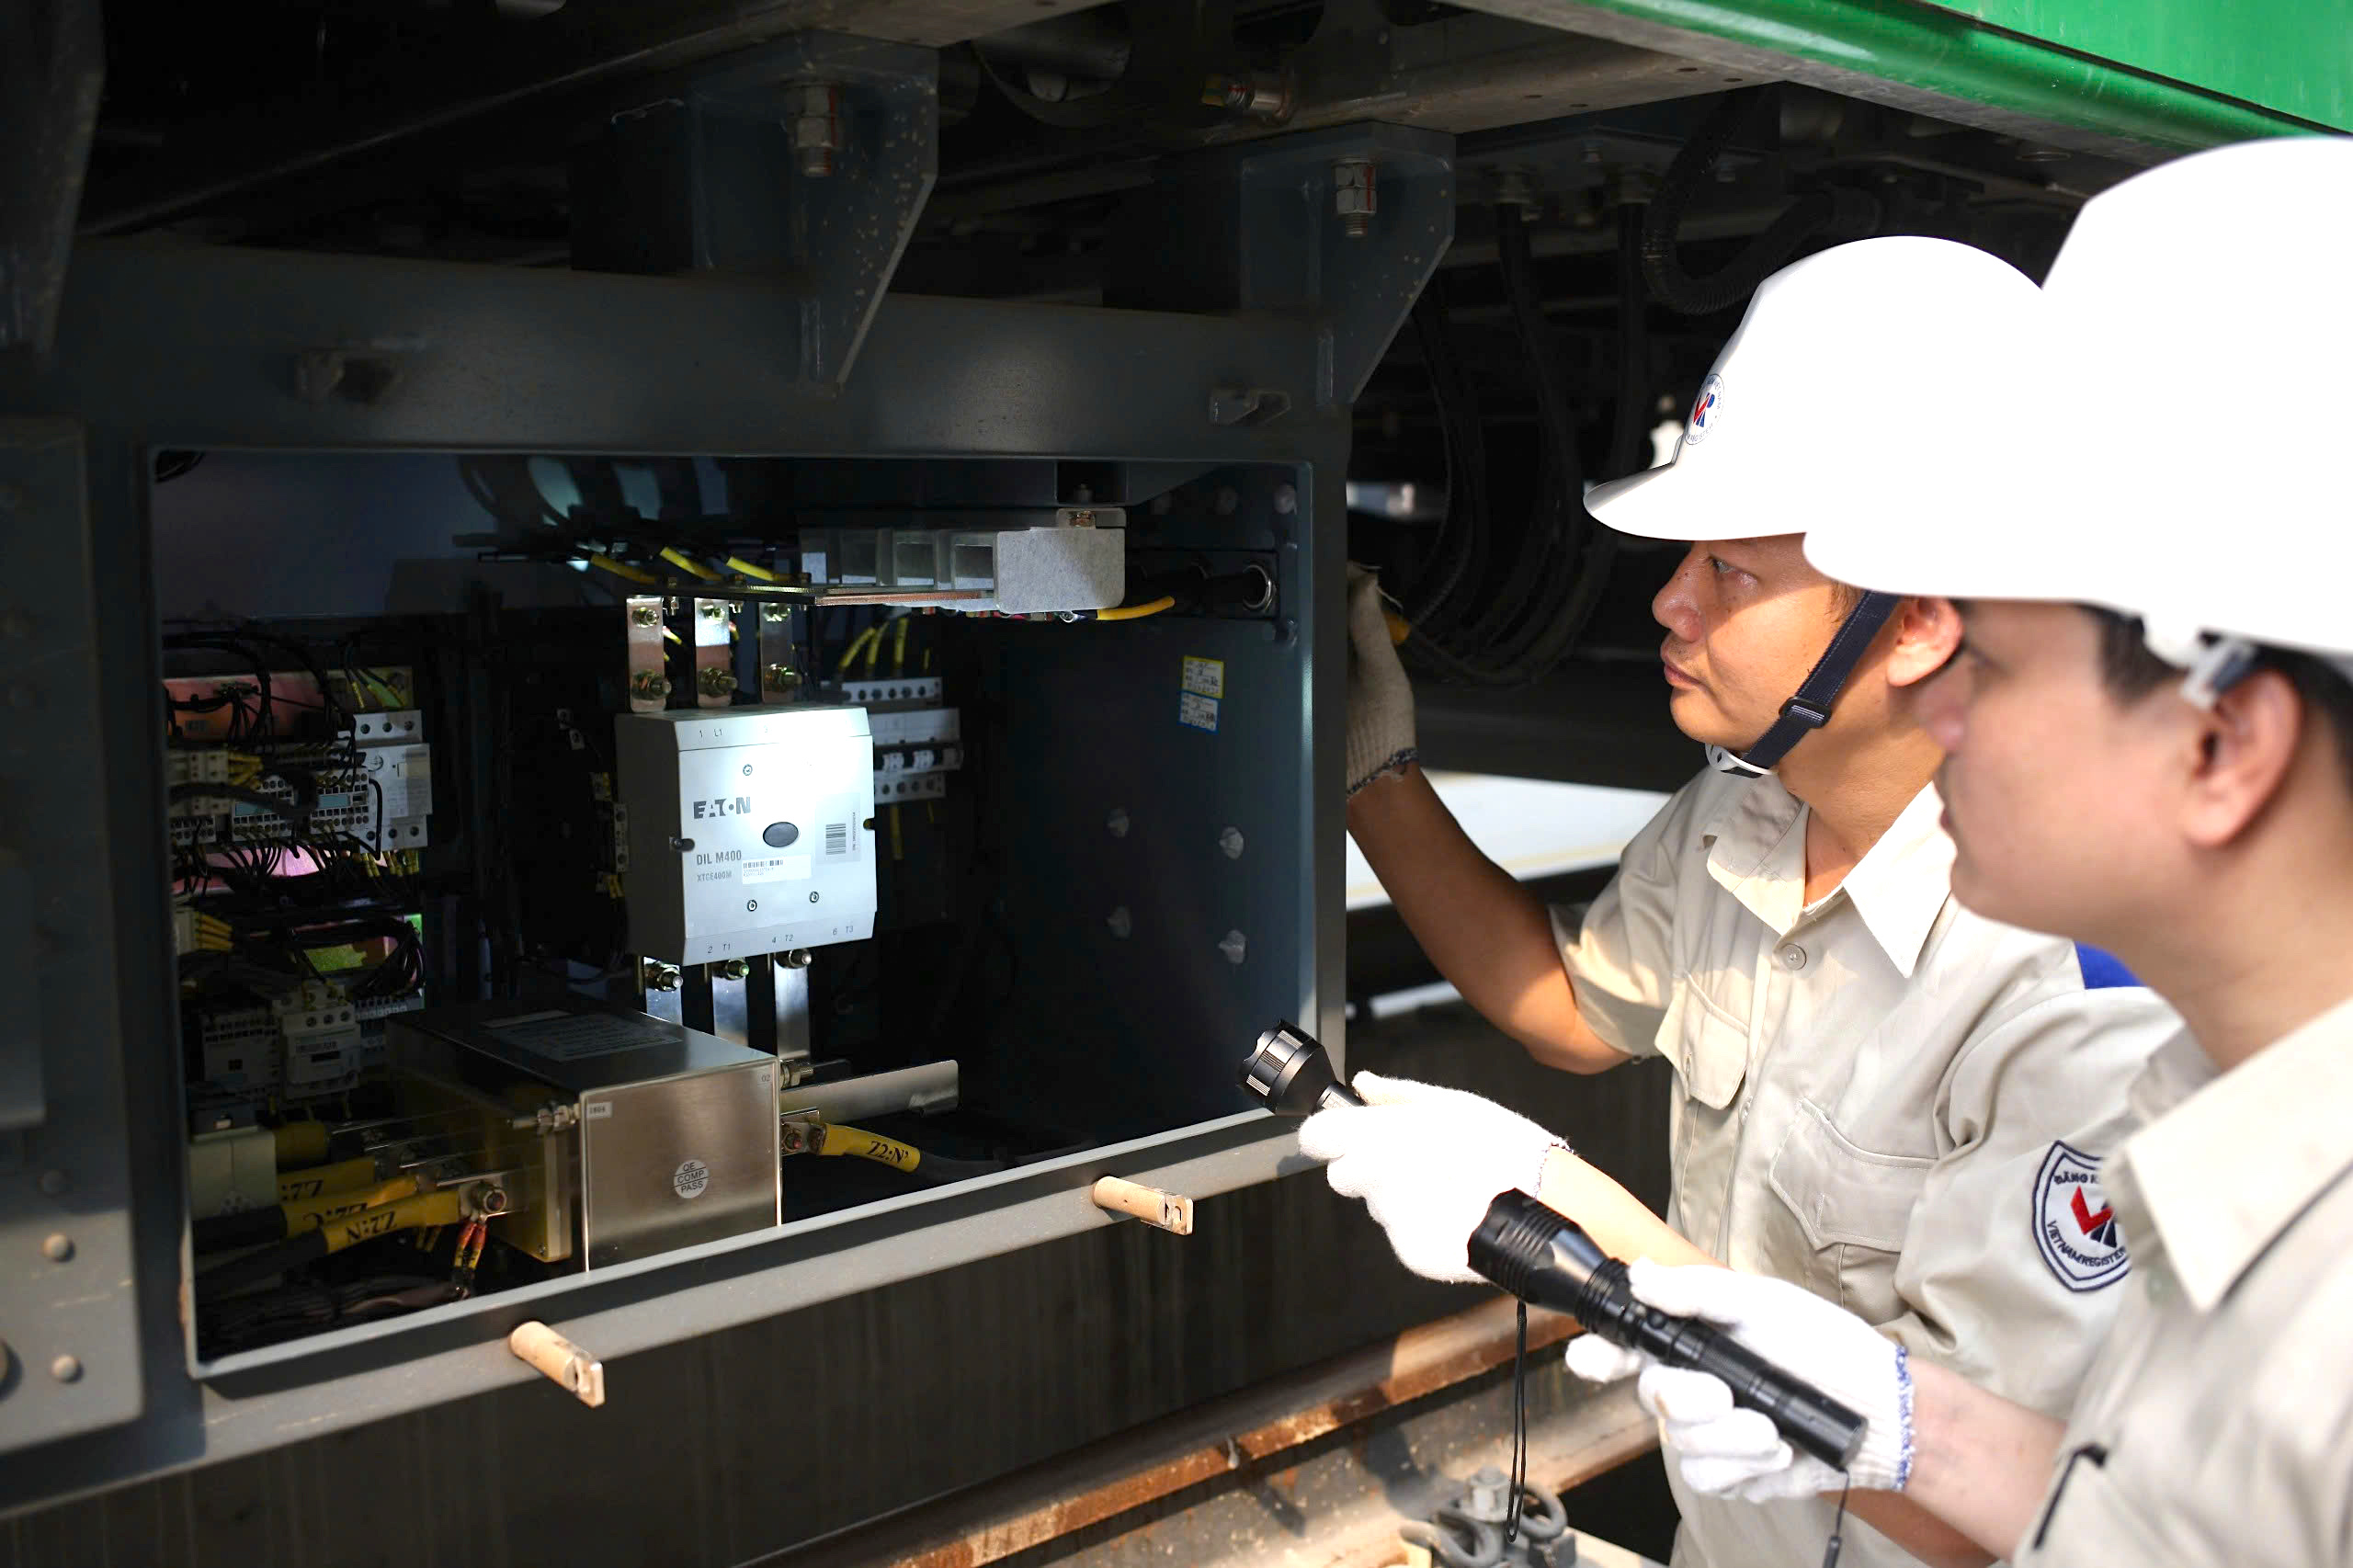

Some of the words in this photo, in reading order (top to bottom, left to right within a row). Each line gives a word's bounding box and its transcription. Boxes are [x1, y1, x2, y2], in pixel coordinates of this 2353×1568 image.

[697, 853, 712, 865] DIL
[716, 850, 742, 863] M400
[676, 1169, 704, 1184] COMP
[680, 1180, 703, 1193] PASS
